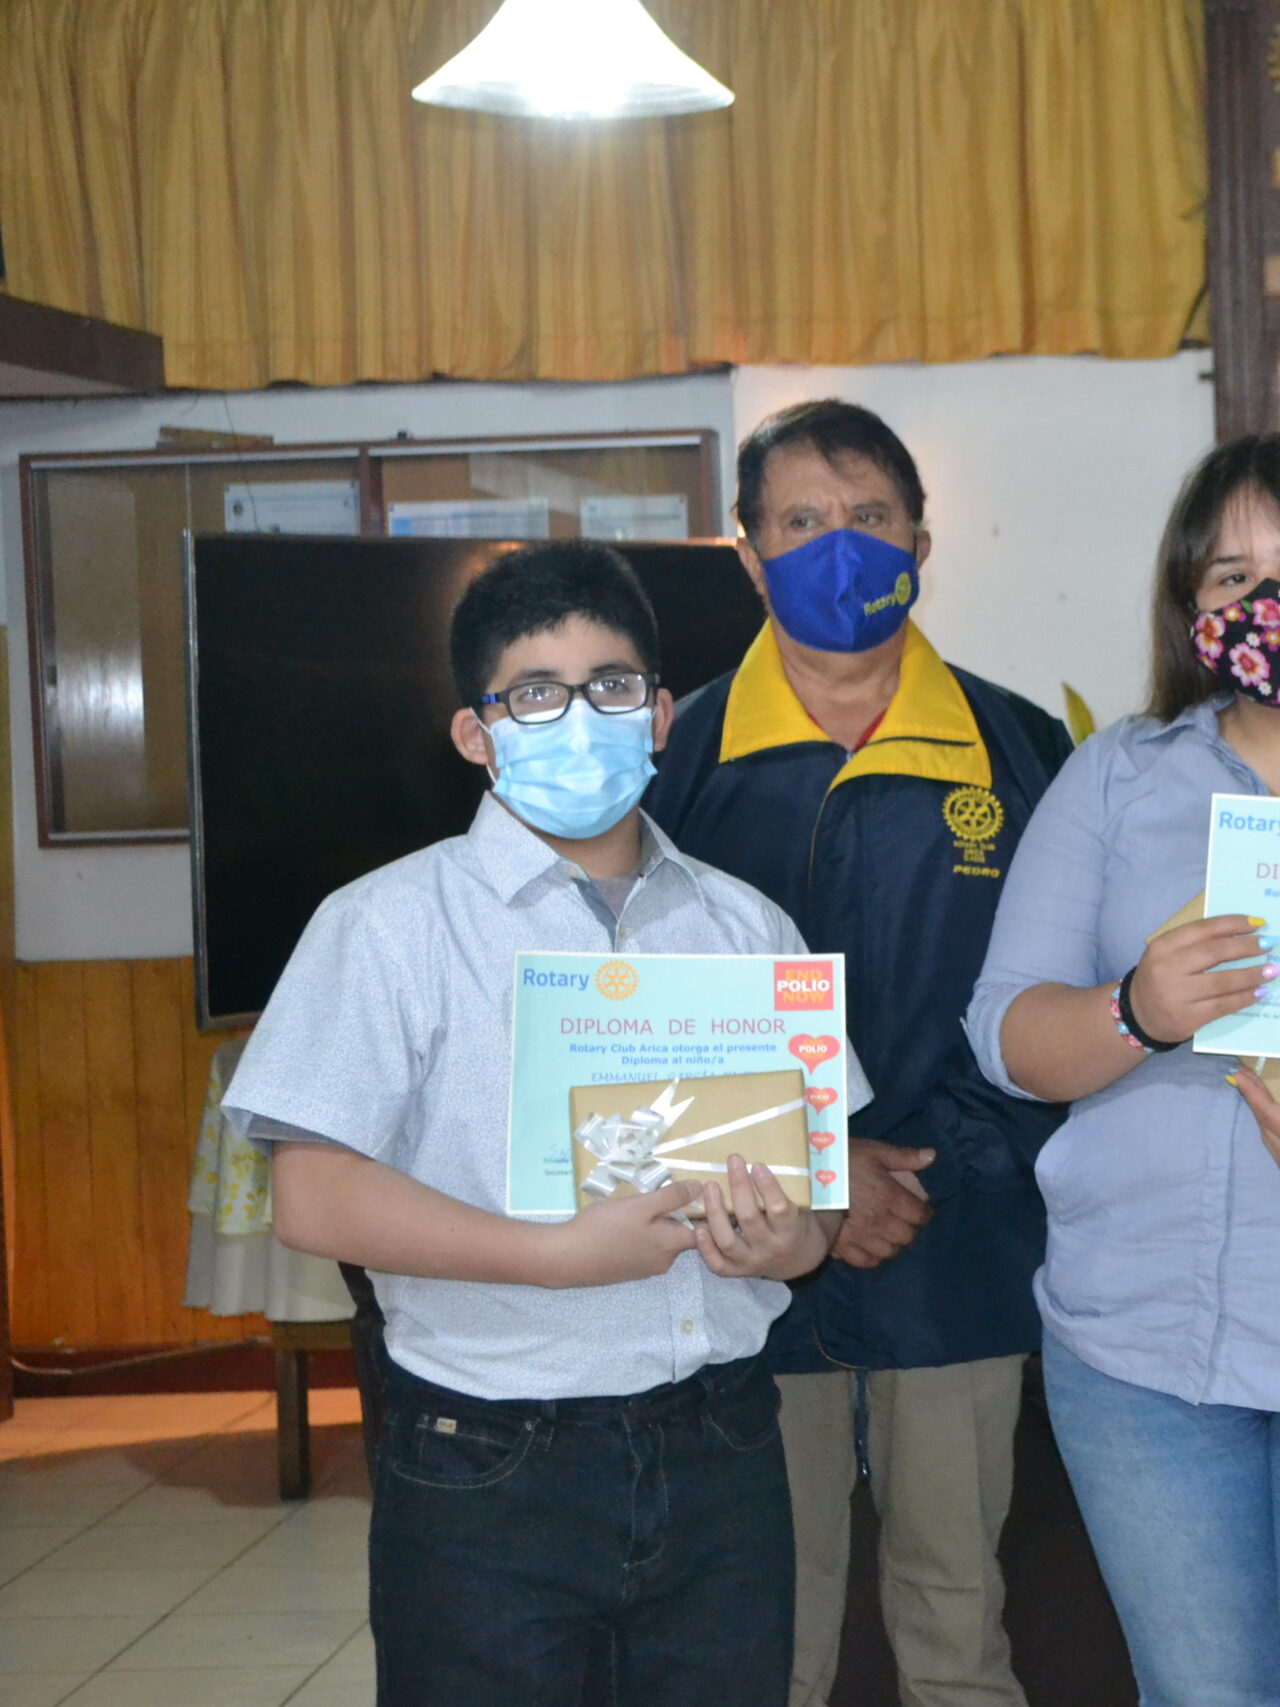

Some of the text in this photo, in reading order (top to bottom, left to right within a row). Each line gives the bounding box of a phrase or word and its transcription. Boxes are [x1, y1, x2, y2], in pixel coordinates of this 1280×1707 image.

[864, 593, 896, 616] Rotary
[953, 865, 1000, 878] PEDRO
[523, 968, 590, 991] Rotary
[777, 980, 830, 992] POLIO
[560, 1018, 786, 1035] DIPLOMA DE HONOR
[570, 1044, 777, 1054] Rotary Club Arica otorga el presente
[799, 1045, 827, 1053] POLIO
[621, 1056, 724, 1066] Diploma al niño/a
